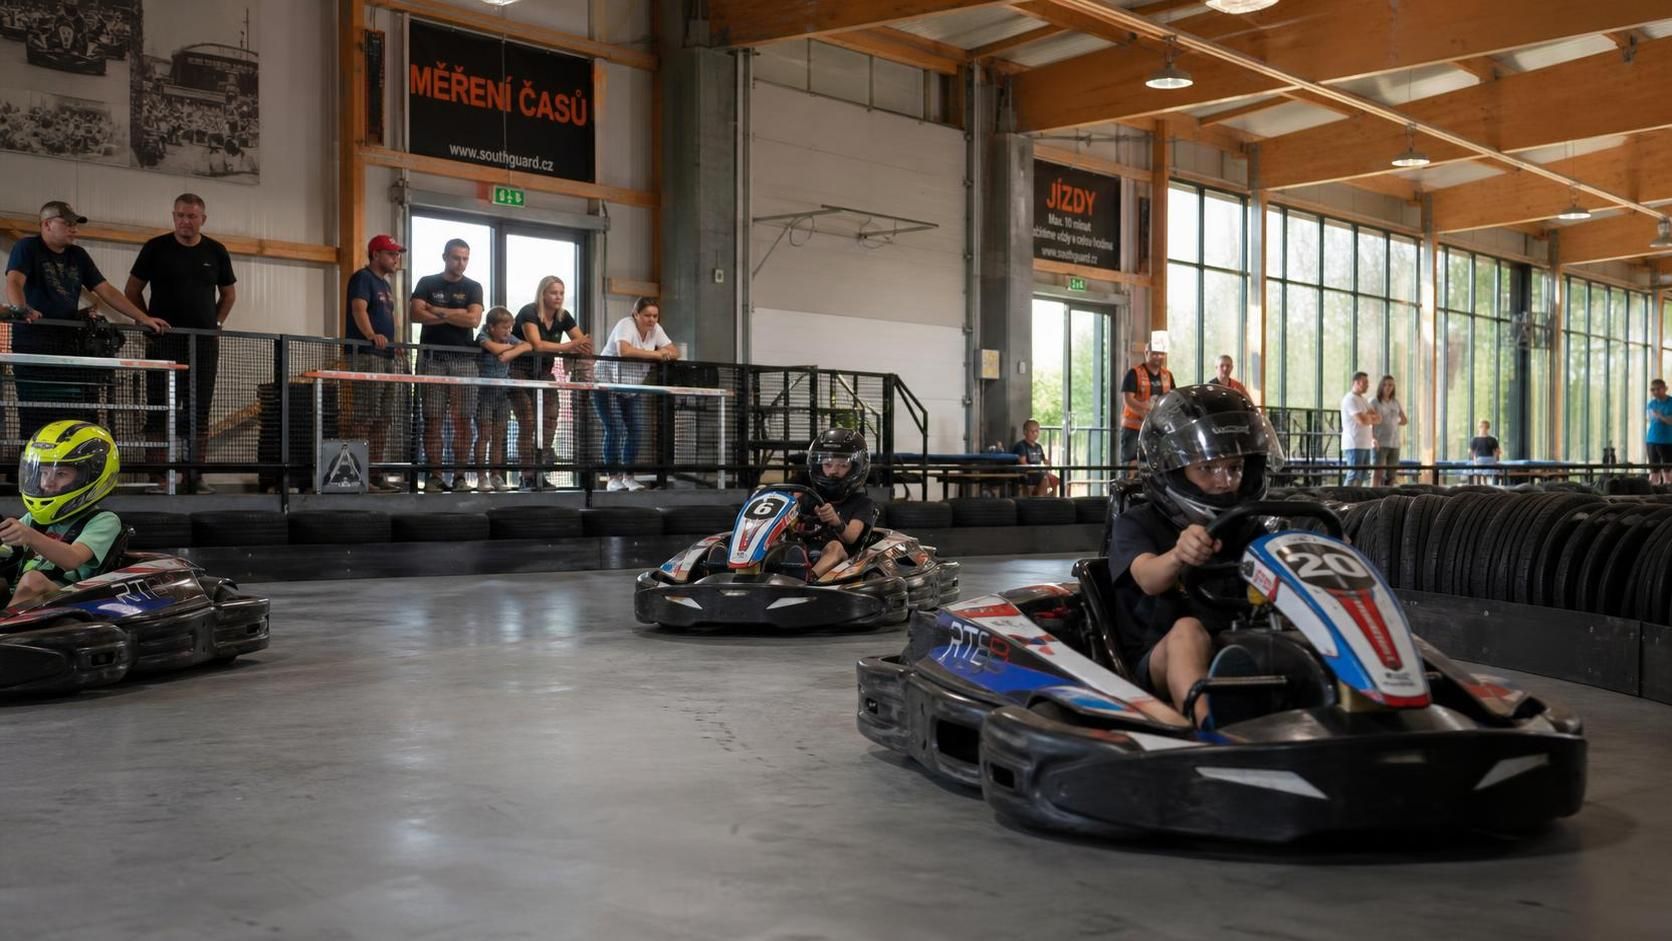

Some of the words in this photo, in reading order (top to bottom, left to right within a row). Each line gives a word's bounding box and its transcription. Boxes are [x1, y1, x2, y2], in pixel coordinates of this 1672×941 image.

[410, 61, 512, 112] MĚŘENÍ
[518, 80, 587, 126] ČASŮ
[449, 144, 554, 171] www.southguard.cz
[1046, 178, 1096, 216] JÍZDY
[1065, 216, 1072, 228] 10
[753, 502, 774, 515] 6
[1287, 552, 1370, 578] 20
